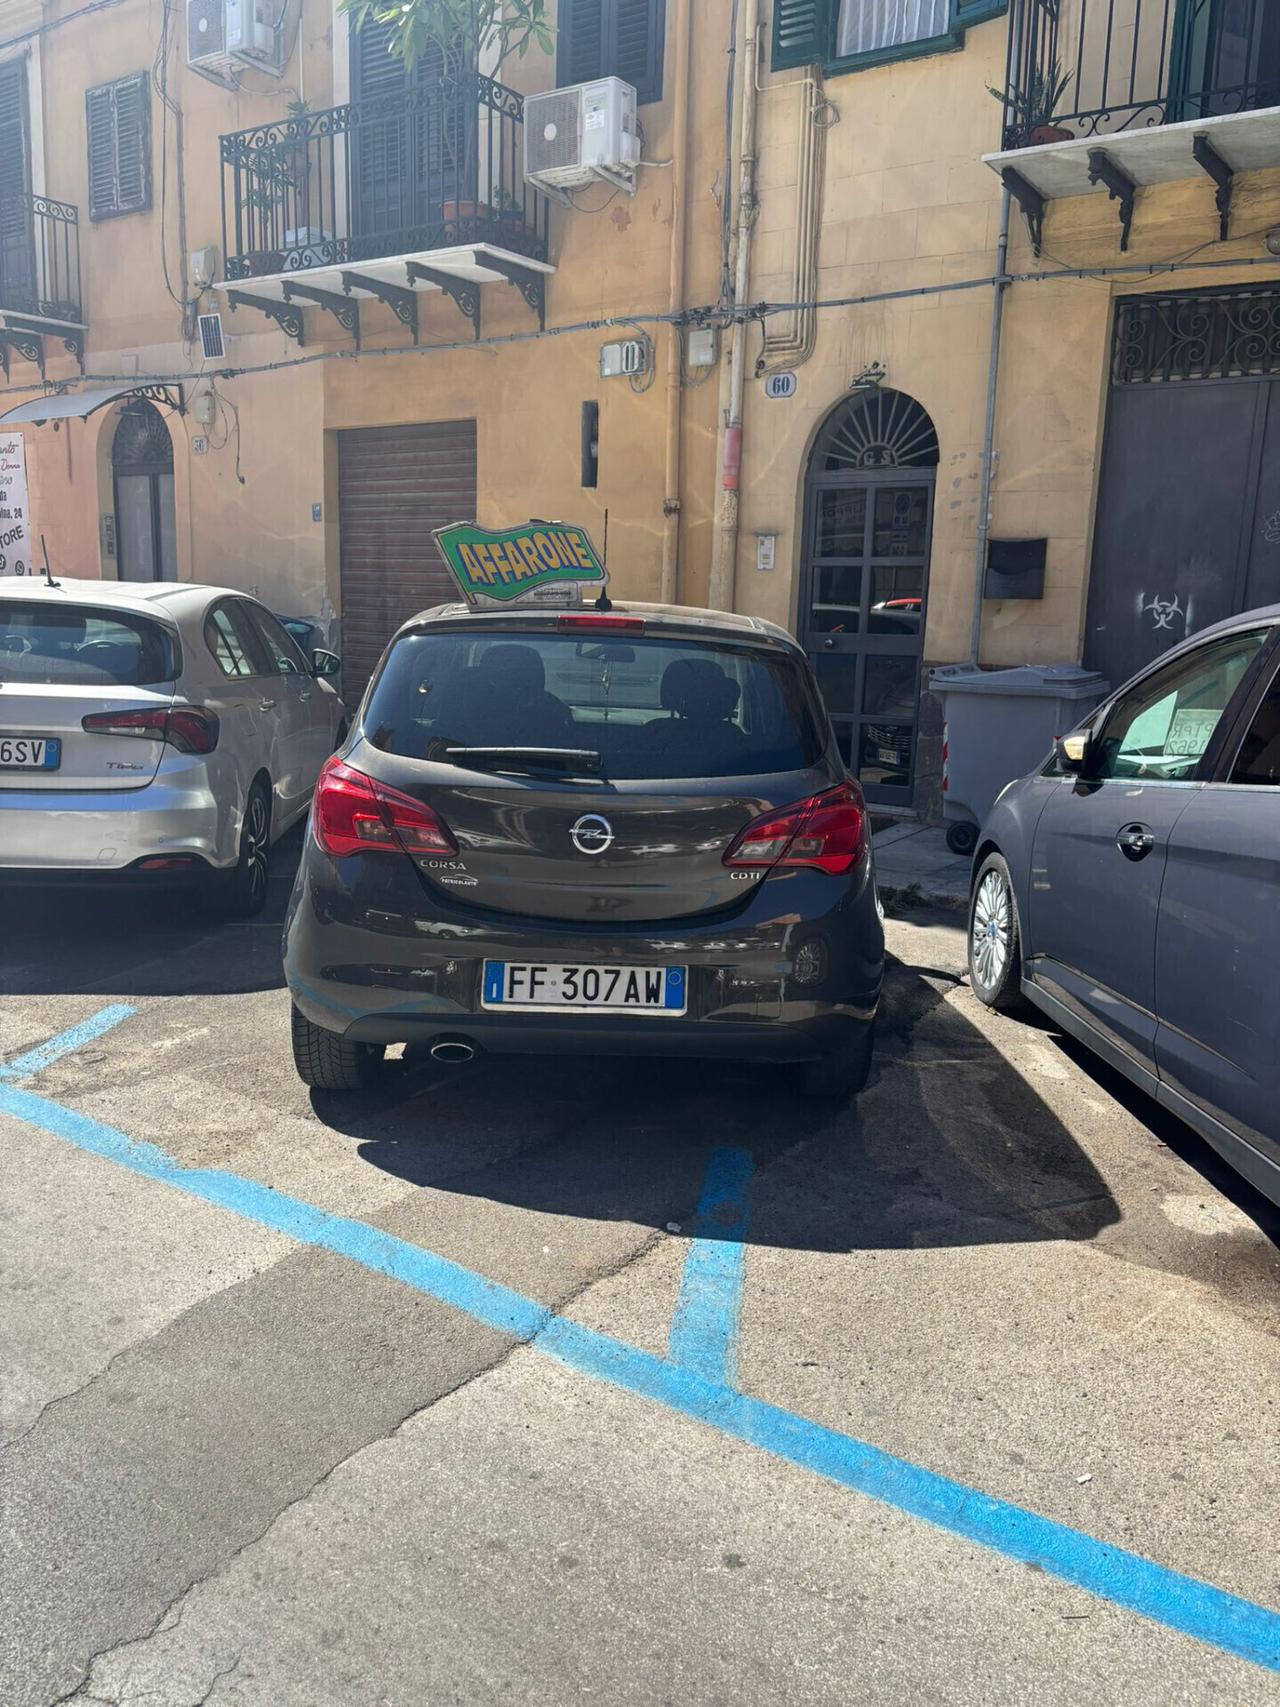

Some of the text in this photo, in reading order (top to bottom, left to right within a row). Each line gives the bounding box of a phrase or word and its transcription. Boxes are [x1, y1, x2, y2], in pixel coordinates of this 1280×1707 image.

[772, 376, 790, 394] 60
[456, 531, 594, 584] AFFARONE
[0, 740, 43, 763] 6SV
[420, 859, 467, 870] CORSA
[730, 871, 760, 880] CDTI
[508, 966, 662, 1004] FF 307AW
